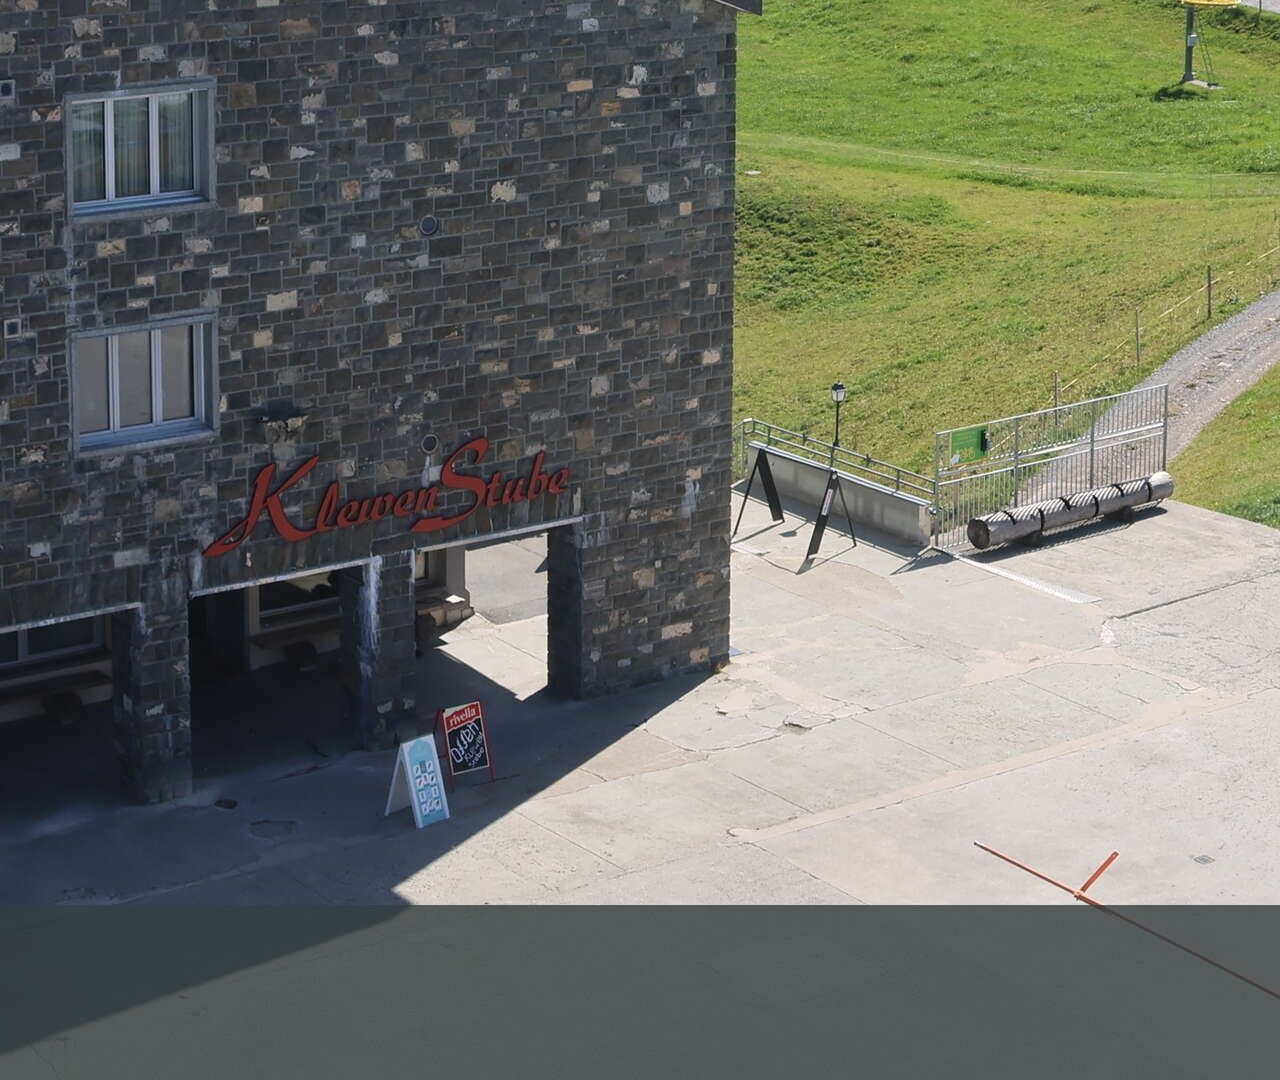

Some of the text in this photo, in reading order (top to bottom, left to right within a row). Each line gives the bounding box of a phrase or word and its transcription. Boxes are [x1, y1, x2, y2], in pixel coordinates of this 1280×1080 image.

[203, 438, 571, 557] Klewen Stube
[449, 707, 477, 727] rivella
